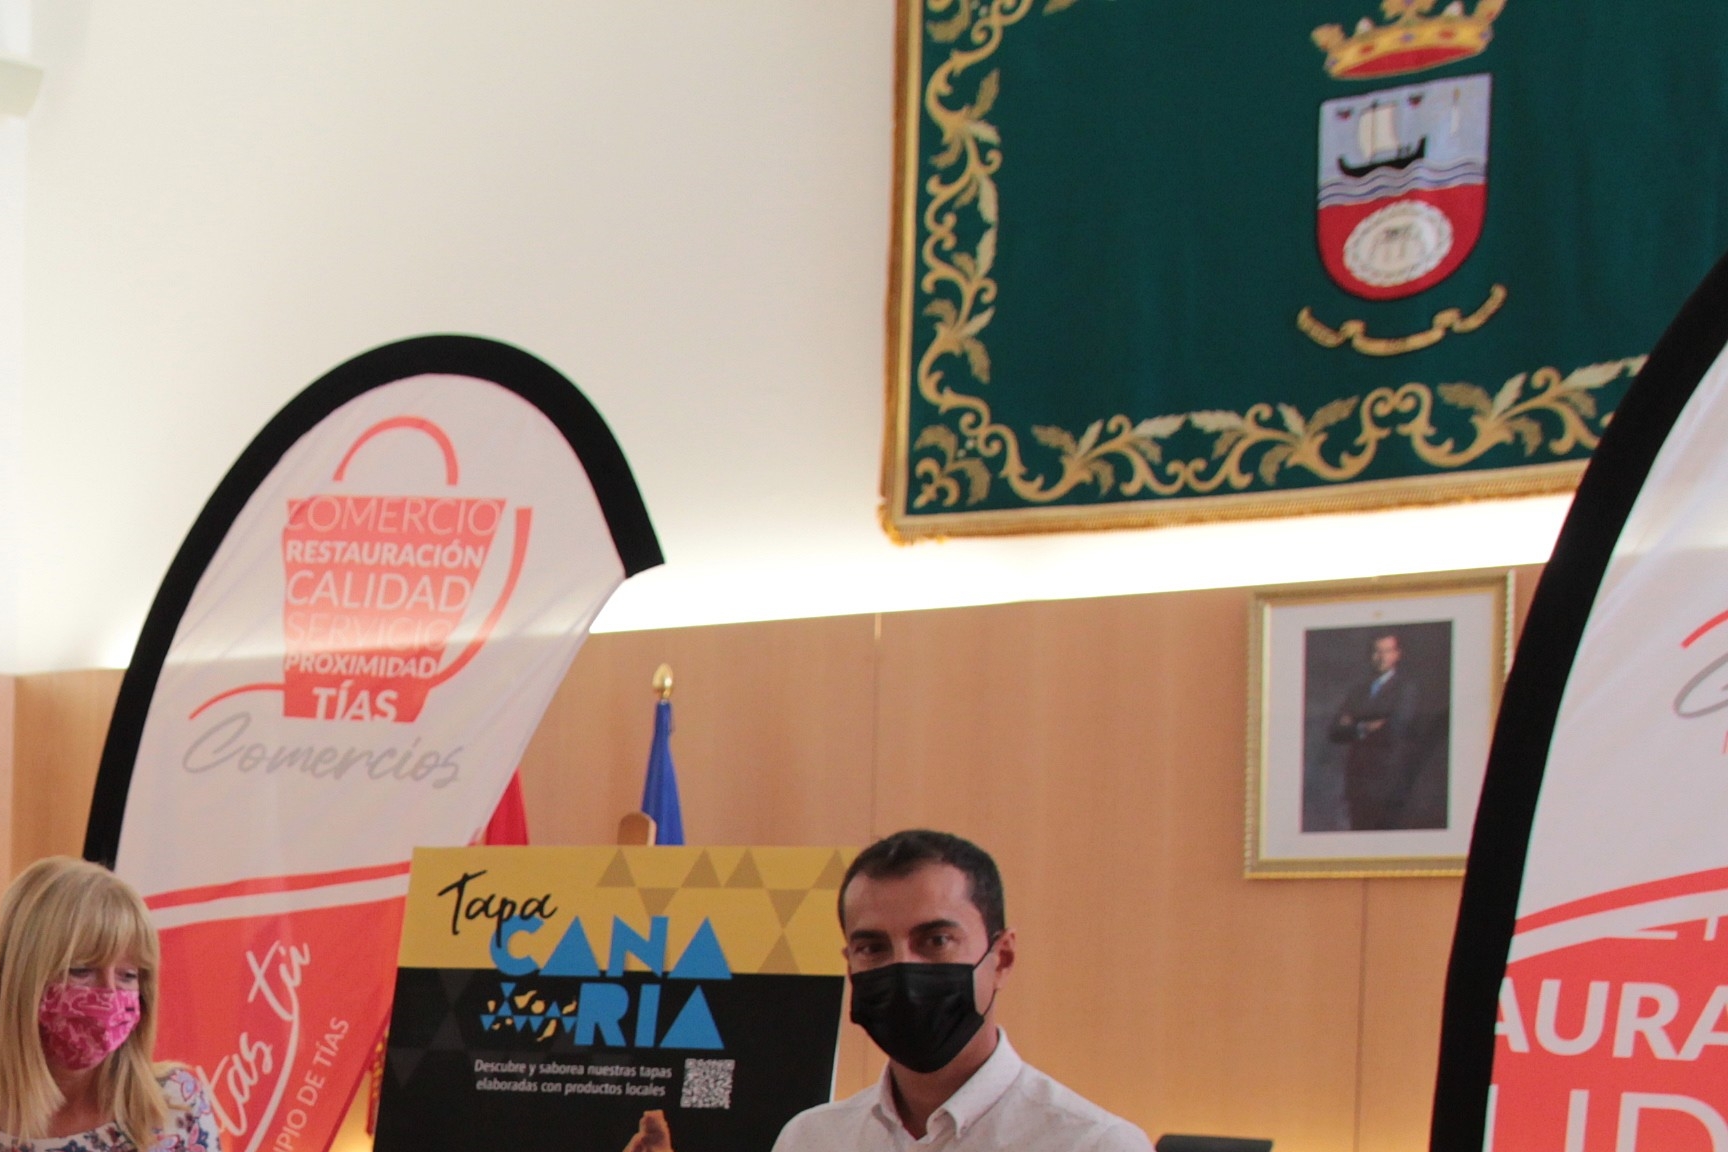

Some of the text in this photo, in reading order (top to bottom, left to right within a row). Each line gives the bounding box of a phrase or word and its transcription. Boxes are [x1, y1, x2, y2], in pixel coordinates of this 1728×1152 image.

[287, 496, 501, 537] COMERCIO
[286, 539, 485, 569] RESTAURACIÓN
[287, 569, 471, 613] CALIDAD
[285, 653, 437, 679] PROXIMIDAD
[312, 679, 399, 722] TÍAS
[183, 711, 465, 790] Comercios
[437, 869, 559, 949] Tapa
[489, 913, 733, 980] CANA
[574, 981, 725, 1050] RIA
[297, 1070, 327, 1108] DE
[312, 1016, 350, 1070] TÍAS
[474, 1058, 673, 1081] Descubre y saborea nuestras tapas
[476, 1077, 666, 1097] elaboradas con productos locales
